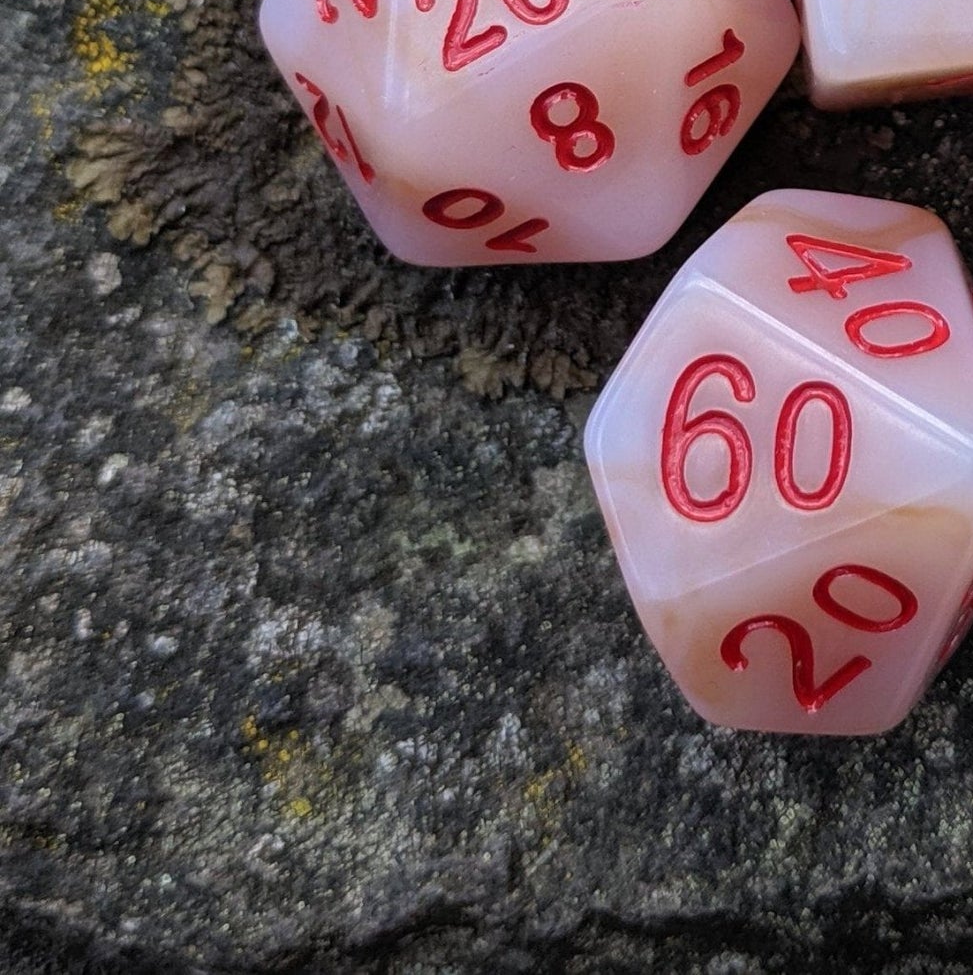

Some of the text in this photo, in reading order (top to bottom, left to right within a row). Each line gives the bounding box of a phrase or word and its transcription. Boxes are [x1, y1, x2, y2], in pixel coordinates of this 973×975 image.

[529, 82, 616, 174] 8
[680, 29, 747, 156] 16
[422, 188, 550, 255] 10
[785, 233, 951, 360] 40
[660, 354, 852, 523] 60
[719, 563, 918, 713] 20
